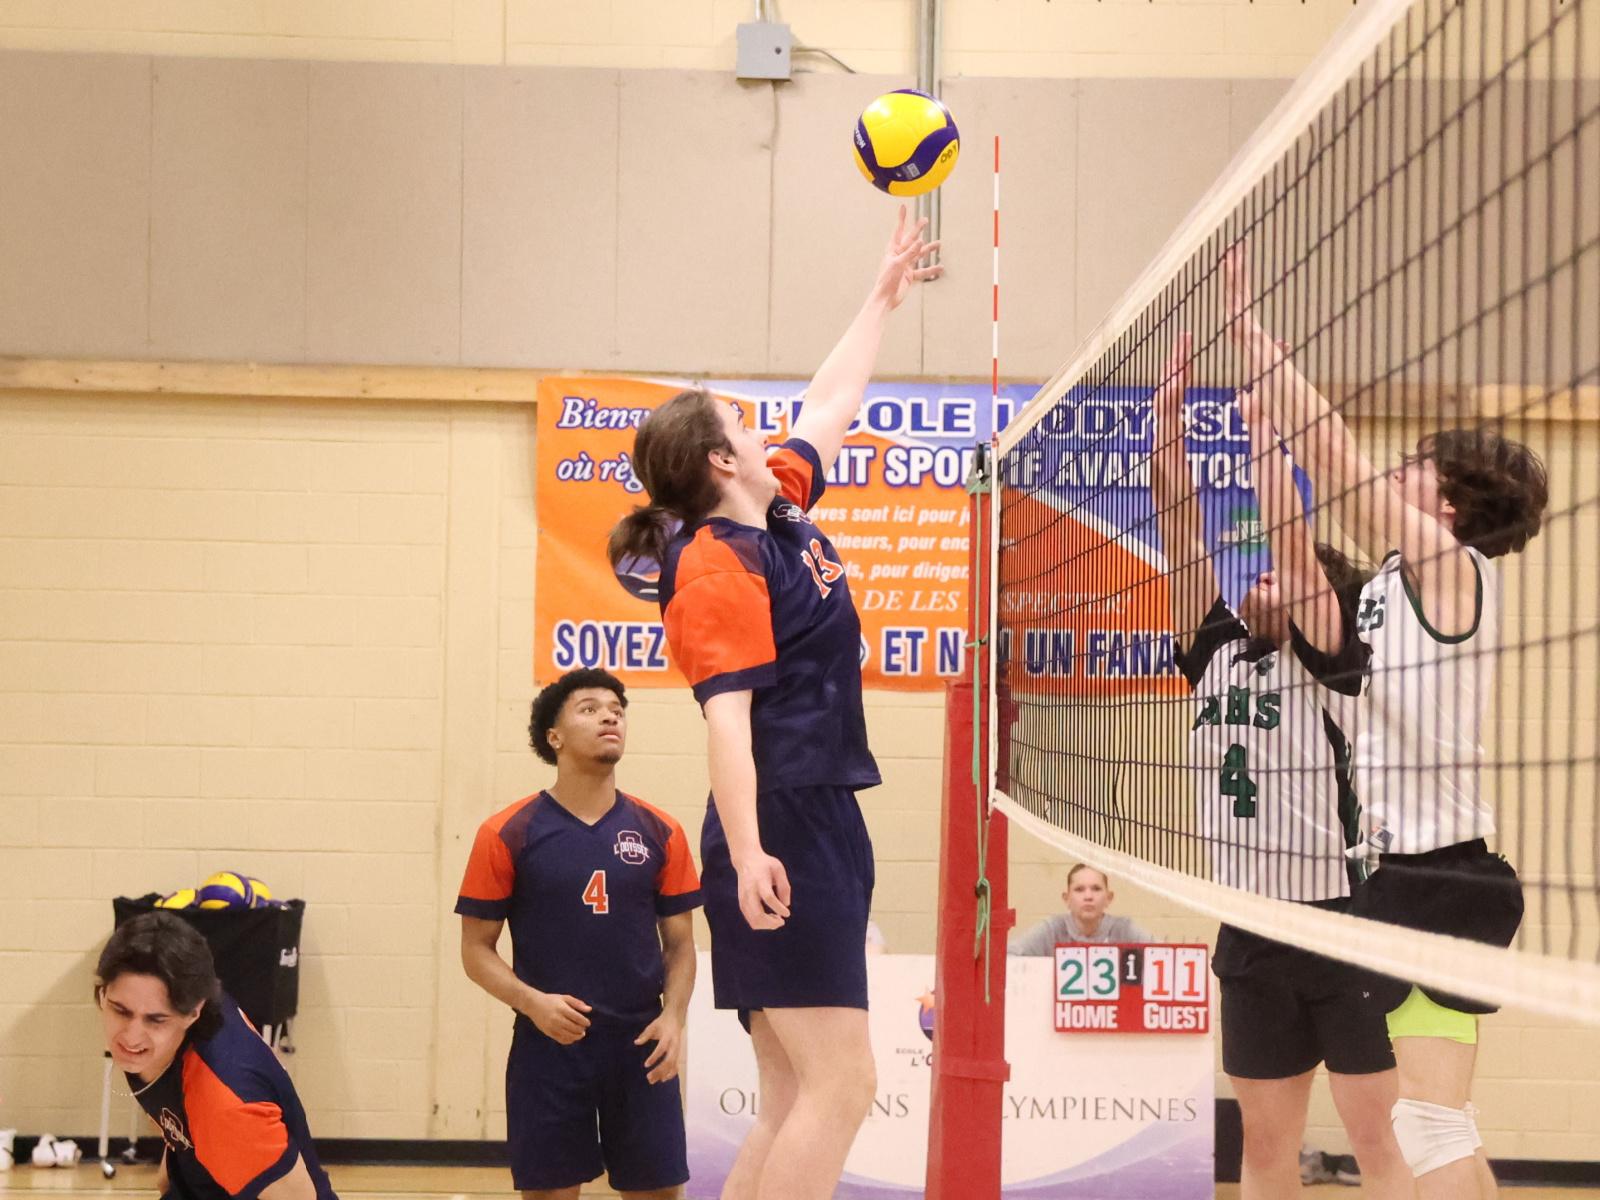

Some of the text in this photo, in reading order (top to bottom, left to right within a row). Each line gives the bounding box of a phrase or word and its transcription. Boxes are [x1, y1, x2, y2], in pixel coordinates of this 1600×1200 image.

[557, 397, 650, 429] Bienv
[557, 451, 593, 481] où
[1055, 451, 1152, 488] AVAN
[1186, 452, 1254, 490] TOU
[851, 505, 890, 522] sont
[893, 505, 915, 522] ici
[917, 508, 957, 526] pour
[897, 536, 937, 553] pour
[801, 538, 845, 600] 13
[868, 563, 909, 580] pour
[862, 589, 904, 611] DE
[909, 590, 961, 612] LES
[555, 621, 669, 670] SOYEZ
[883, 629, 926, 675] ET
[1025, 630, 1073, 676] UN
[1220, 743, 1256, 818] 4
[581, 869, 609, 914] 4
[1060, 957, 1117, 995] 23
[1056, 1002, 1208, 1030] HOME GUEST
[1003, 1096, 1197, 1123] YMPIENNES
